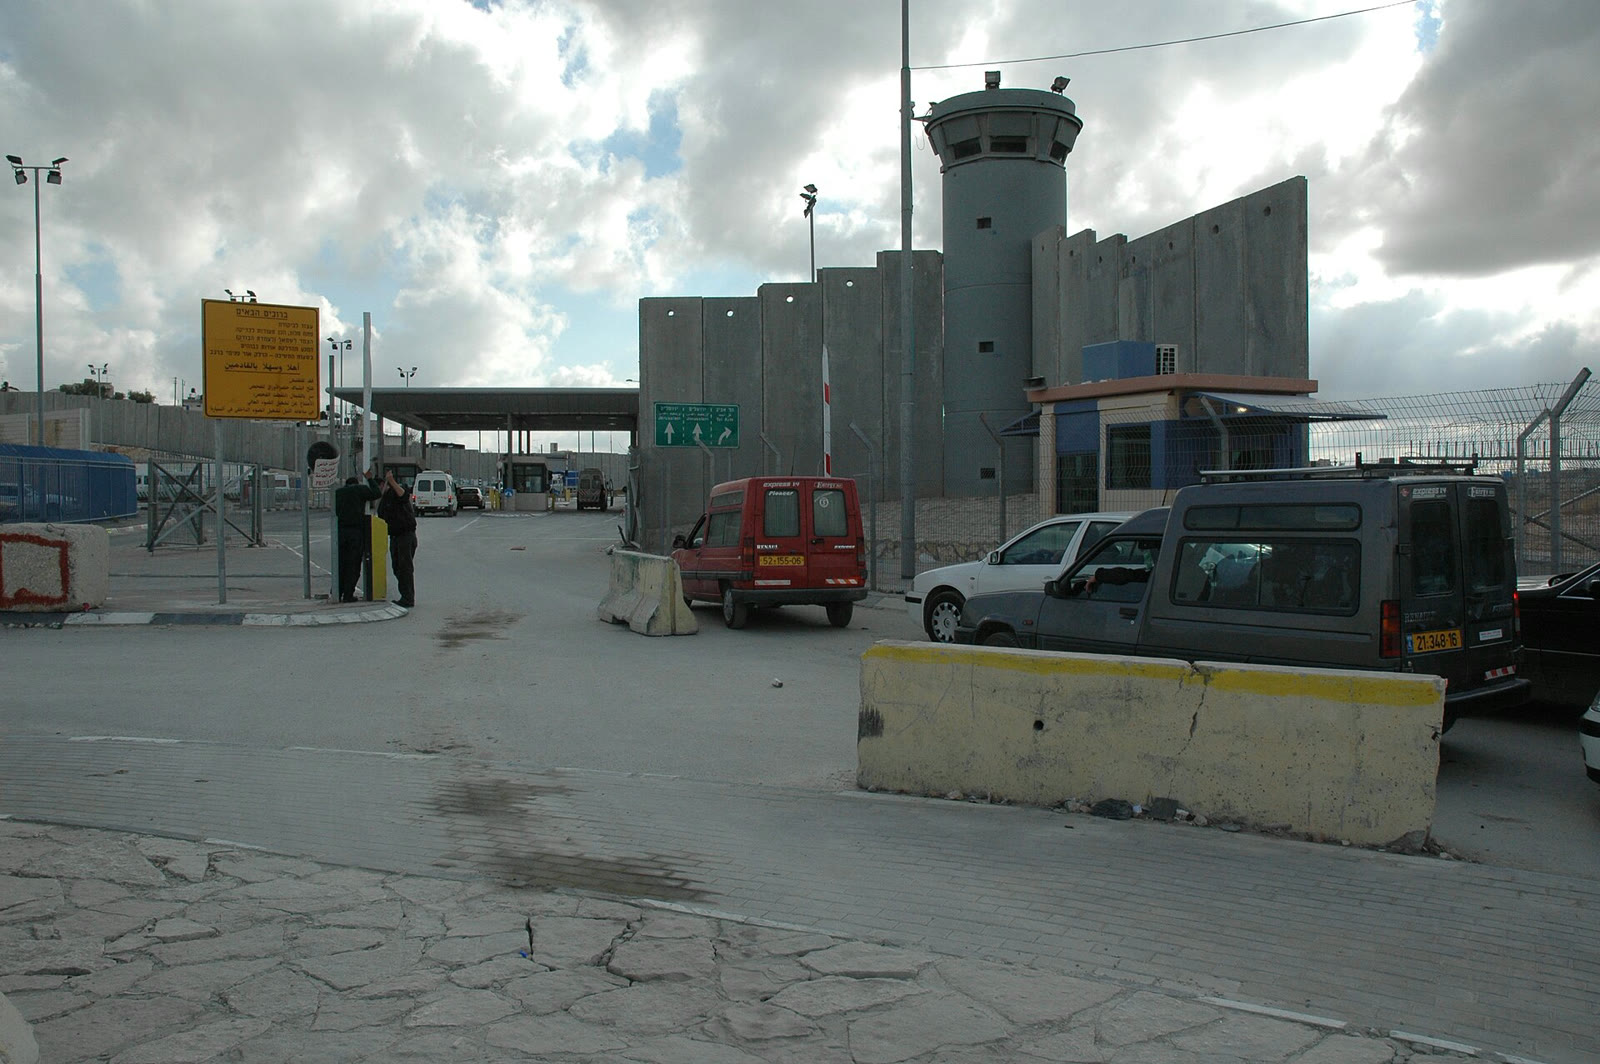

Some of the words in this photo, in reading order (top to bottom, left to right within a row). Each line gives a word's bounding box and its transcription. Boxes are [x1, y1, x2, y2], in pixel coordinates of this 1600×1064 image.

[236, 308, 260, 317] הבאים
[263, 310, 288, 319] ברוכים
[1412, 487, 1439, 496] express
